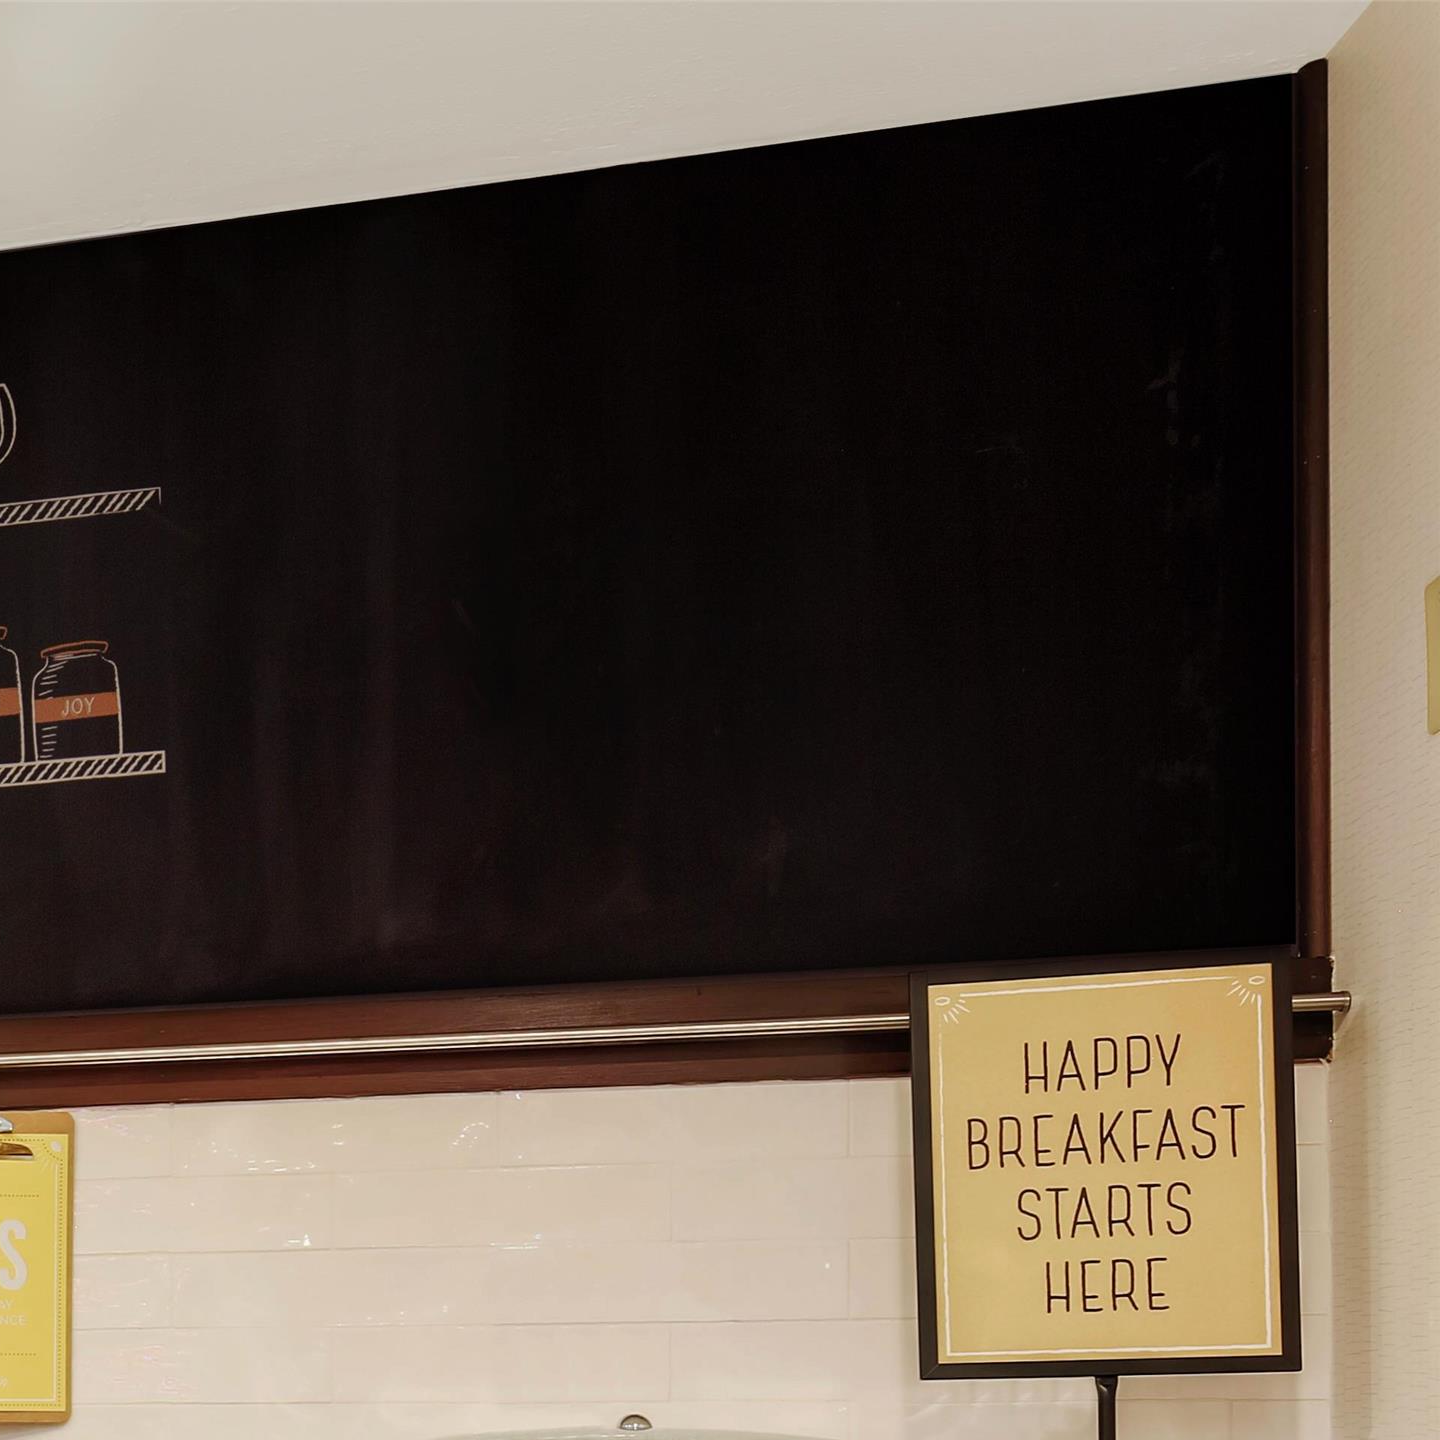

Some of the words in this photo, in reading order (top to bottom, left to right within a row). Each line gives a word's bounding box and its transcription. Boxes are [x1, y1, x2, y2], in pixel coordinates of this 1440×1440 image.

[60, 697, 96, 717] JOY
[1023, 1033, 1182, 1094] HAPPY
[966, 1104, 1246, 1171] BREAKFAST
[1016, 1181, 1194, 1241] STARTS
[1045, 1257, 1170, 1314] HERE
